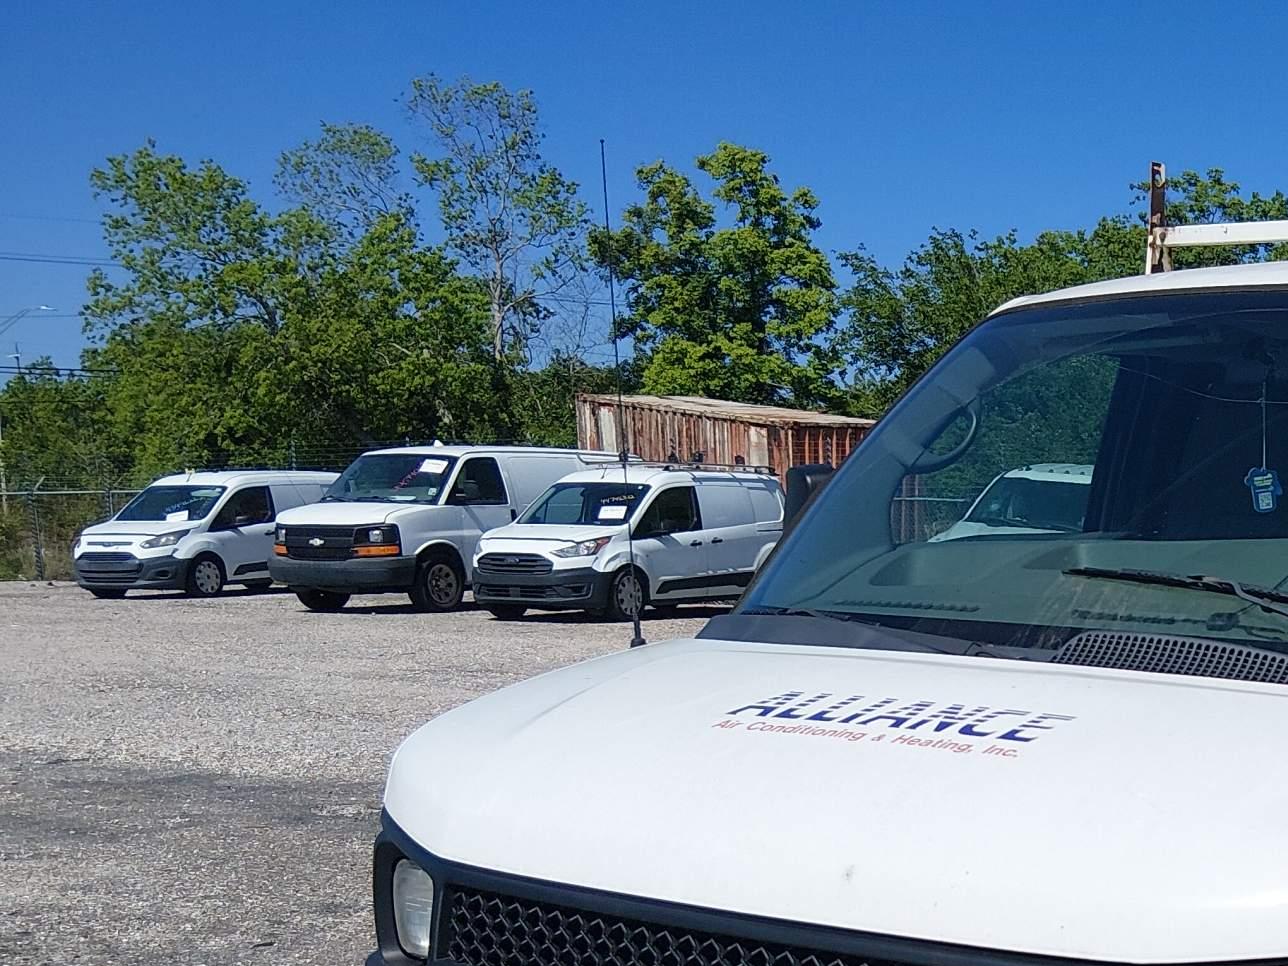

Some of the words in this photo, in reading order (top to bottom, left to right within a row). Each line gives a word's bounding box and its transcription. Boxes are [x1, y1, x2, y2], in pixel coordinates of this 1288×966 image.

[711, 719, 743, 729] Air
[747, 720, 868, 742] Conditioning
[872, 733, 887, 742] &
[891, 734, 975, 754] Heating,
[982, 744, 1019, 759] Inc.
[726, 691, 1077, 742] ALLIANCE
